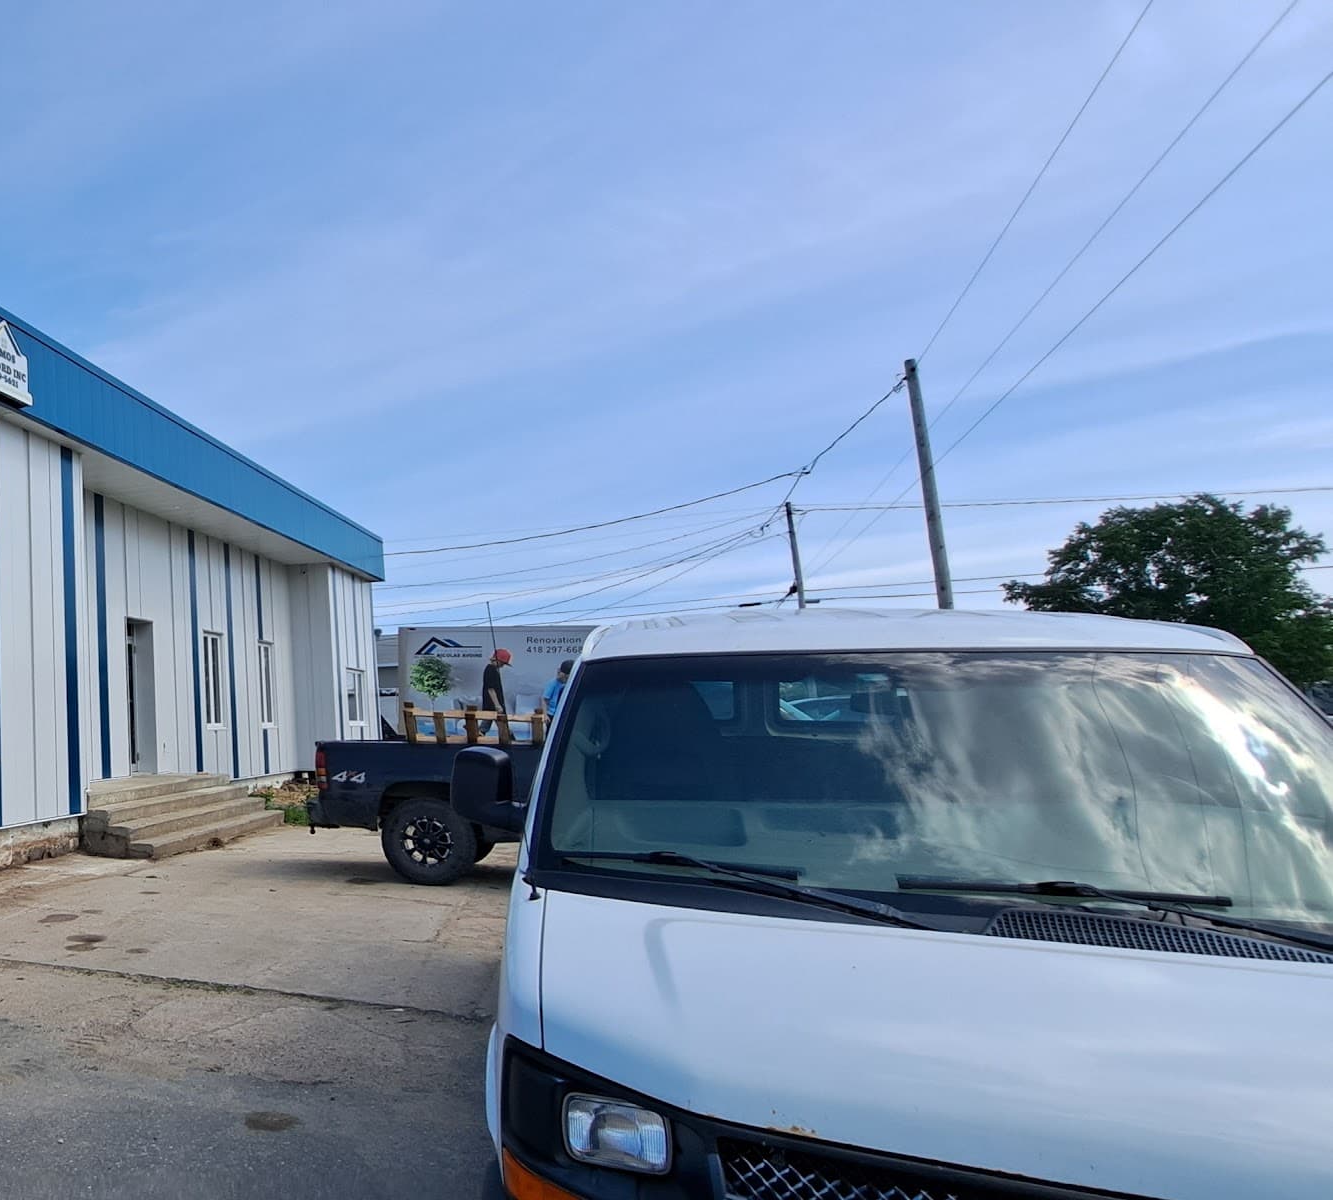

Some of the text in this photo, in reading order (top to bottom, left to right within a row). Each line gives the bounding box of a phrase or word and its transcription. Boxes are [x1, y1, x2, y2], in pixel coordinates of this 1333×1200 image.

[13, 368, 26, 383] INC
[526, 636, 582, 644] Renovation
[526, 646, 544, 654] 418
